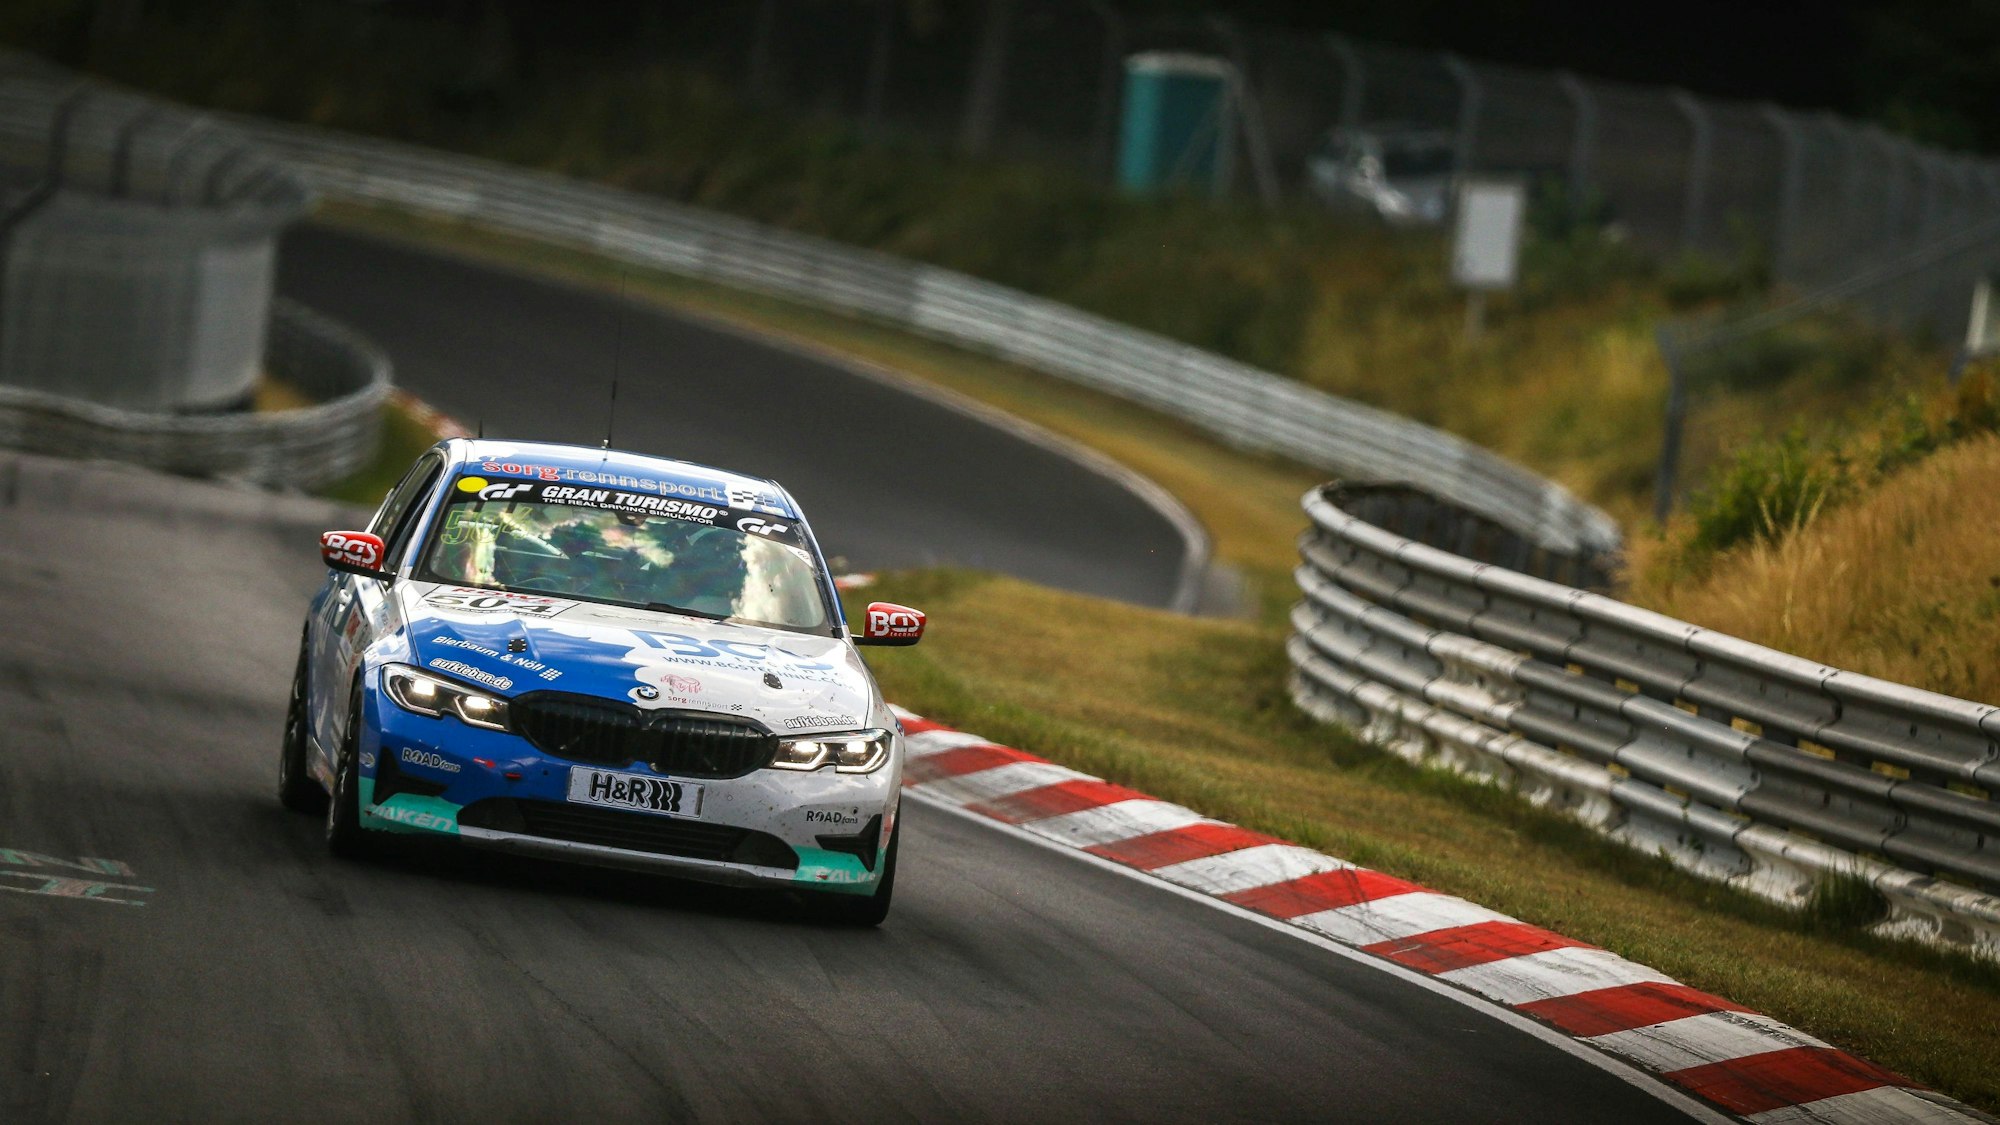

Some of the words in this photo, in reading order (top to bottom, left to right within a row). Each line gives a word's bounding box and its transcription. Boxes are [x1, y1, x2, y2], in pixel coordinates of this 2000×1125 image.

[481, 461, 560, 481] sorg
[566, 468, 724, 500] rennsport
[541, 485, 610, 503] GRAN
[568, 500, 597, 508] REAL
[600, 503, 646, 513] DRIVING
[648, 509, 714, 525] SIMULATOR
[326, 534, 376, 564] BGS
[425, 595, 553, 613] 504
[869, 611, 920, 636] BGS
[432, 635, 500, 658] Bierbaum
[500, 653, 514, 662] &
[515, 657, 546, 672] Nöll
[430, 658, 513, 691] aufkleben.de
[668, 695, 688, 705] sorg
[784, 713, 858, 730] aufkleben.de
[589, 772, 651, 807] H&R
